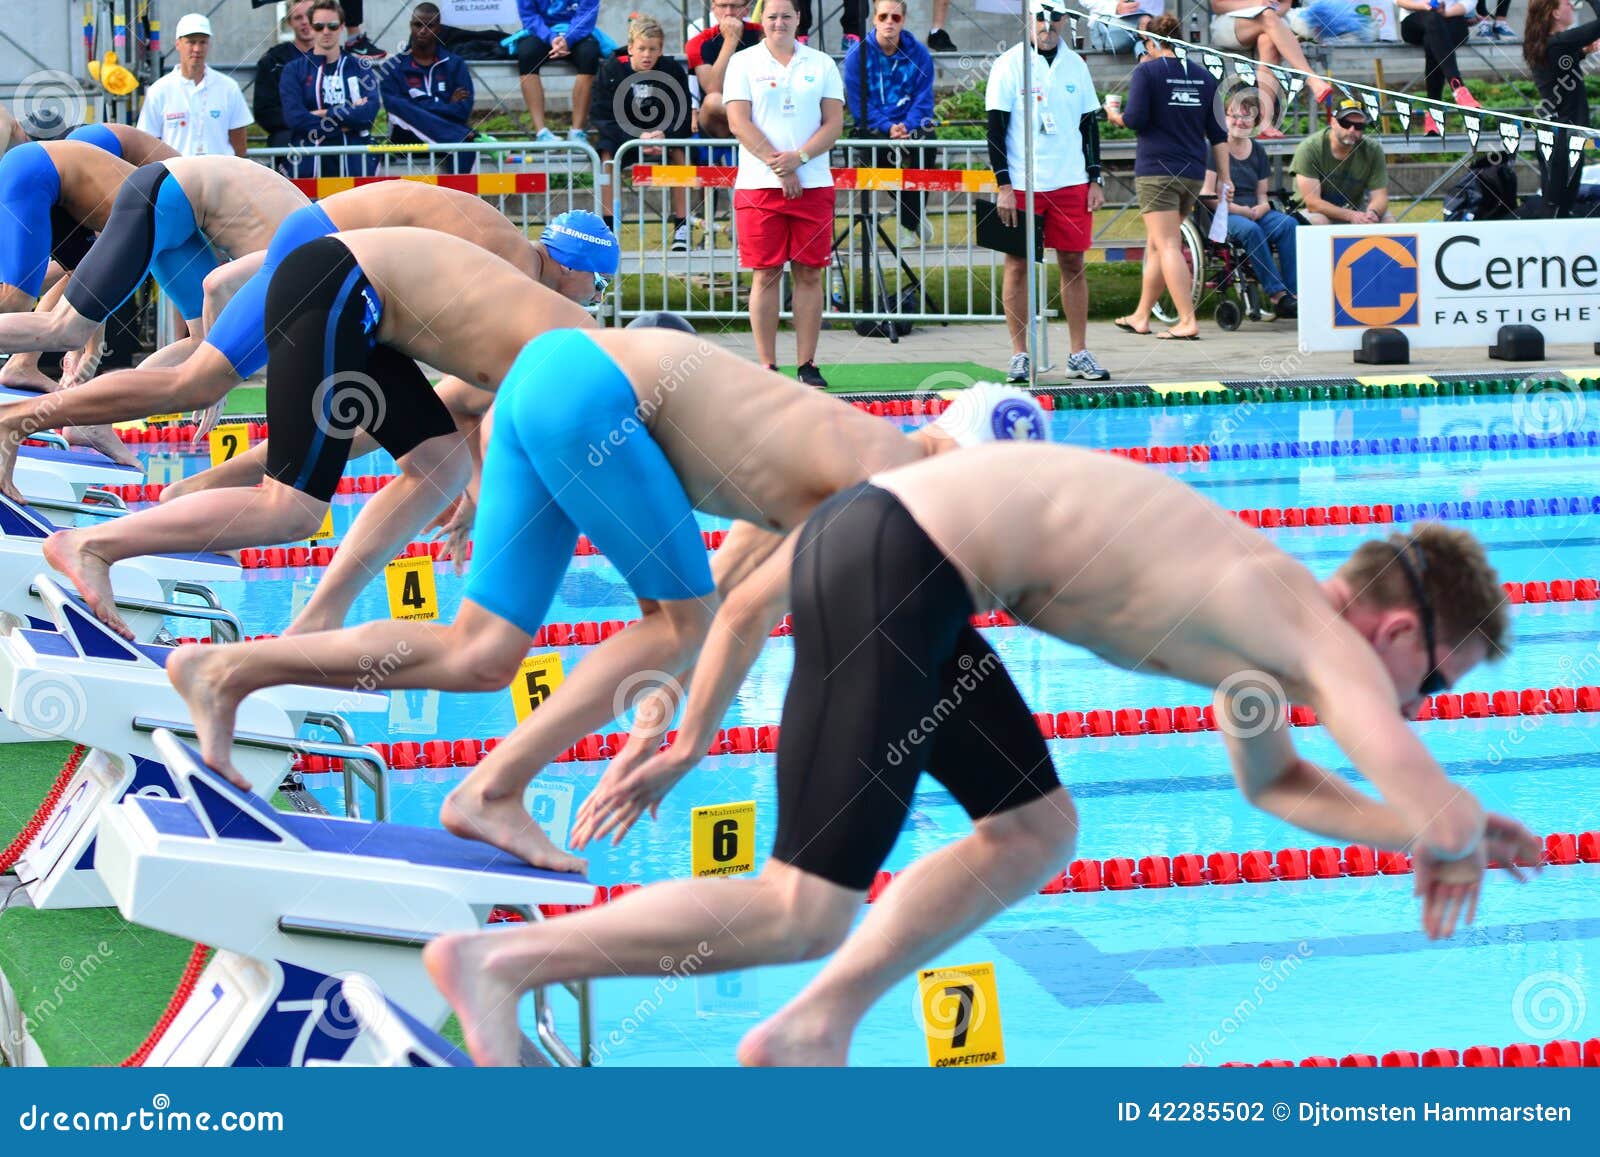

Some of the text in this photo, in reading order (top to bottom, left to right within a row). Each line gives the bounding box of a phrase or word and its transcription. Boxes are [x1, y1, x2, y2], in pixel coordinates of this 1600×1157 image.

[454, 4, 500, 12] DELTAGARE
[1434, 234, 1598, 291] Cerne
[1434, 306, 1600, 325] FASTIGHE
[222, 434, 237, 462] 2
[402, 570, 426, 609] 4
[525, 669, 551, 711] 5
[713, 819, 739, 862] 6
[699, 863, 750, 878] COMPETITOR
[276, 999, 328, 1067] 7
[944, 984, 975, 1049] 7
[935, 1051, 998, 1067] COMPETITOR
